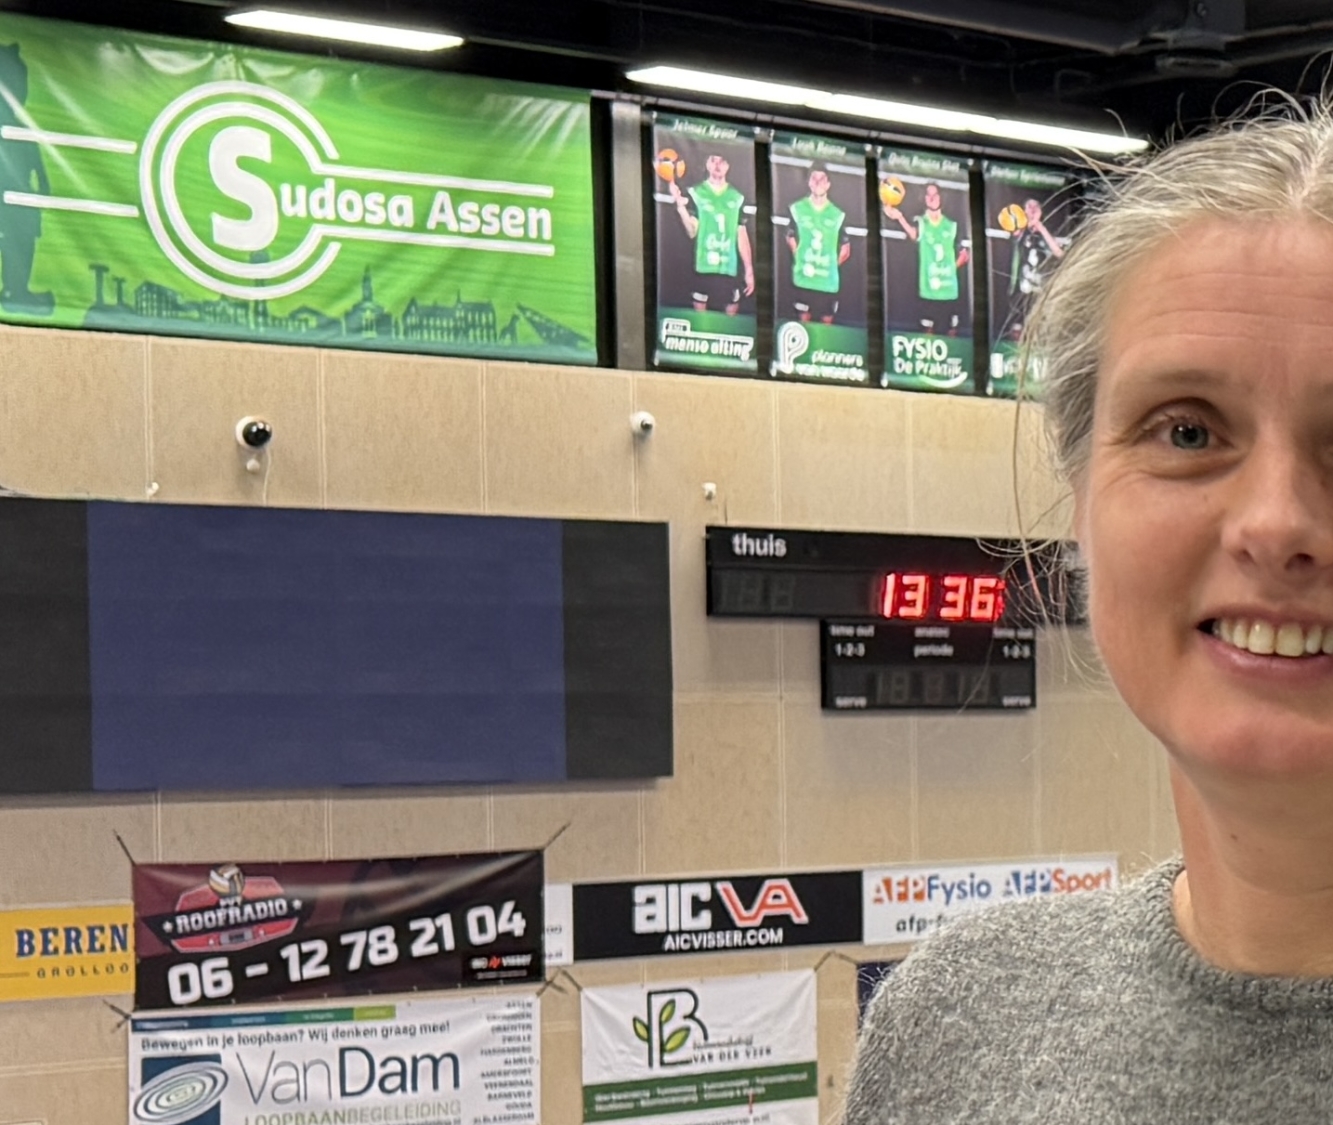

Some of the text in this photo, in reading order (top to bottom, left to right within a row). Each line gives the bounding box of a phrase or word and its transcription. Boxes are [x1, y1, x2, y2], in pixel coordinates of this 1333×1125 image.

[209, 126, 553, 251] Sudosa Assen
[892, 336, 948, 362] FYSIO
[893, 357, 913, 374] De
[732, 533, 787, 557] thuis
[882, 572, 1000, 620] 13 36
[175, 897, 288, 934] ROOFRADIO
[896, 914, 950, 934] afp-f
[15, 923, 129, 958] BEREN
[167, 956, 234, 1005] 06
[280, 939, 331, 982] 12
[340, 925, 399, 971] 78
[409, 912, 456, 958] 21
[466, 900, 527, 946] 04
[664, 927, 784, 951] AICVISSER.COM
[37, 963, 129, 979] GROLLOO
[141, 1037, 203, 1051] Bewegen
[207, 1033, 219, 1046] in
[221, 1033, 234, 1049] je
[238, 1029, 304, 1047] loopbaan?
[309, 1028, 328, 1043] Wij
[331, 1025, 379, 1040] denken
[381, 1024, 417, 1039] graag
[236, 1046, 460, 1105] VanDam
